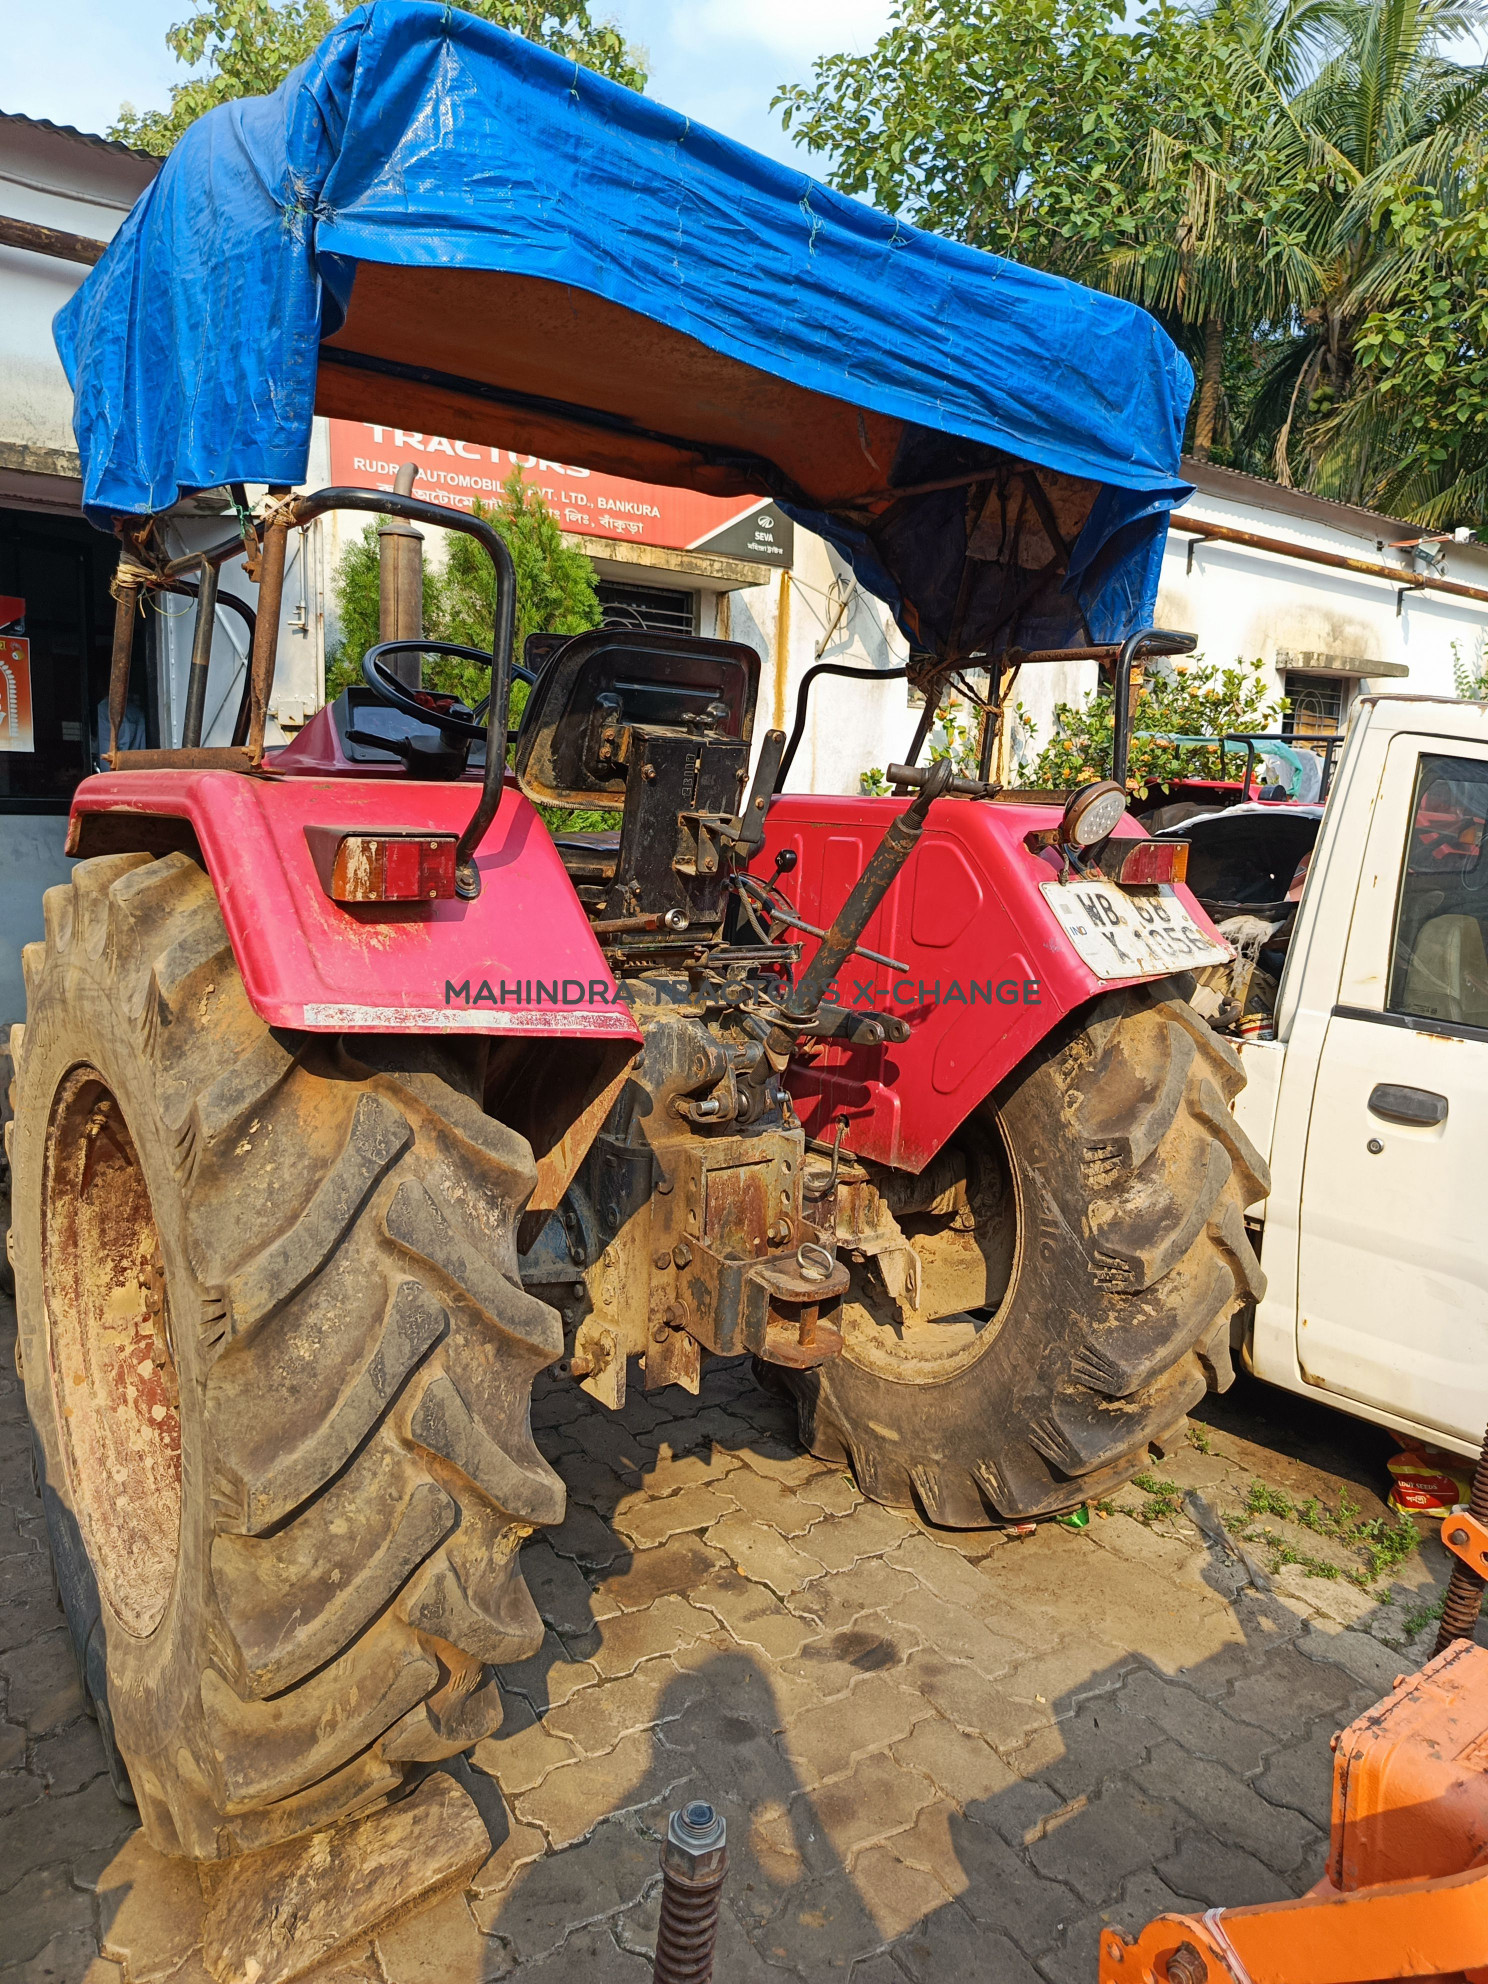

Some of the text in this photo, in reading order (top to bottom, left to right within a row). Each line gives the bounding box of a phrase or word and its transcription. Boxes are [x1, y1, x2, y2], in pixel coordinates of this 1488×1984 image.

[353, 457, 399, 476] RUDR
[415, 468, 522, 497] AUTOMOBIL
[561, 490, 594, 508] LTD.,
[597, 497, 661, 518] BANKURA
[755, 531, 774, 543] SEVA
